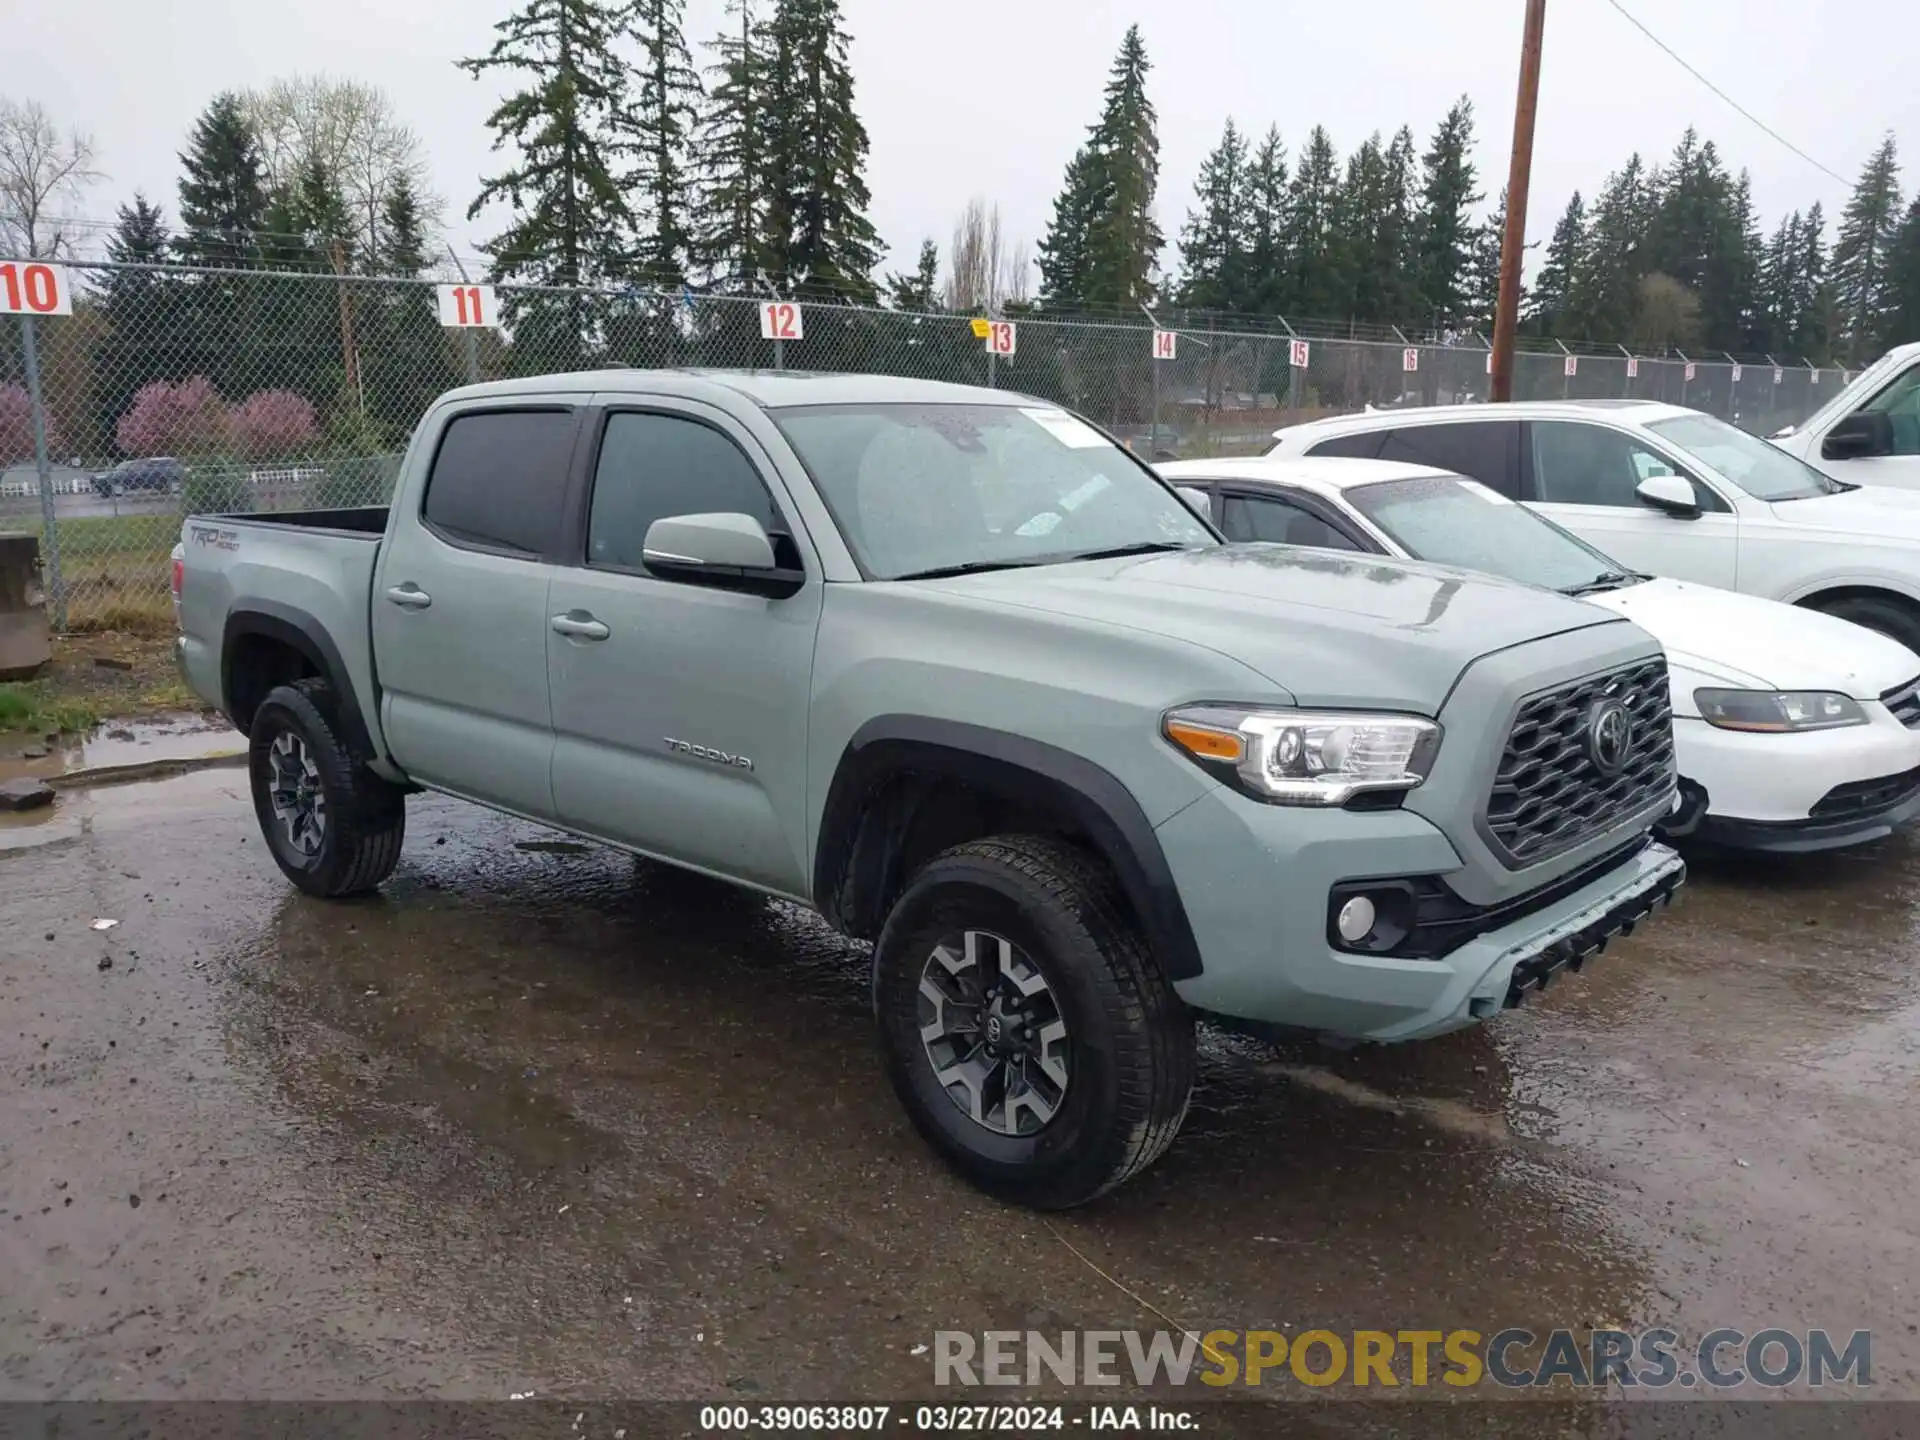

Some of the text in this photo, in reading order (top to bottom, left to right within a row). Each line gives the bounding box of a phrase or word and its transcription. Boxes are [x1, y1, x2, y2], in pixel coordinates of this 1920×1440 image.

[0, 264, 58, 313] 10
[452, 287, 482, 325] 11
[767, 303, 796, 337] 12
[991, 323, 1011, 352] 13
[1156, 332, 1172, 357] 14
[1294, 342, 1306, 365] 15
[1406, 350, 1416, 369] 16
[663, 736, 755, 773] TACOMA
